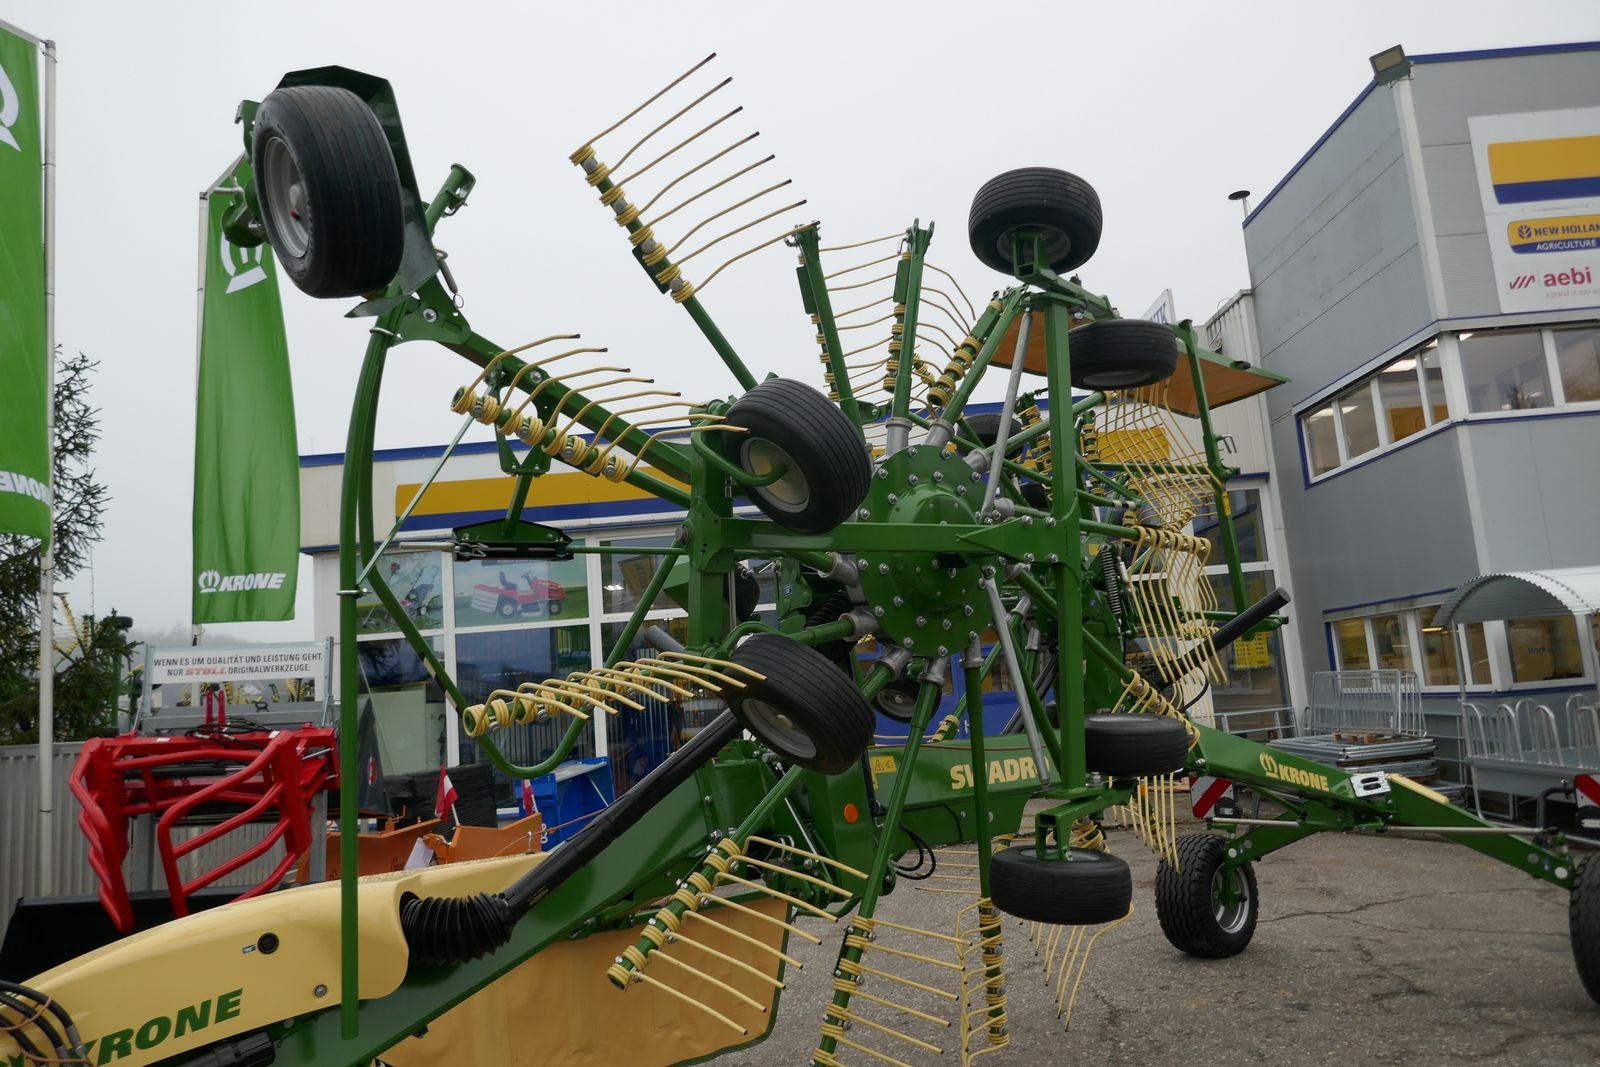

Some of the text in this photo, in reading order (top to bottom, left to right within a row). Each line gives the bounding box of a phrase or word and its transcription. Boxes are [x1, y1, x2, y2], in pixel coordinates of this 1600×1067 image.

[1534, 227, 1559, 236] NEW
[1536, 239, 1597, 251] AGRICULTURE
[1543, 267, 1592, 287] aebi
[219, 573, 287, 592] KRONE
[154, 658, 178, 667] WENN
[180, 657, 190, 665] ES
[191, 657, 205, 665] UM
[206, 654, 243, 665] QUALITÄT
[245, 655, 262, 663] UND
[263, 653, 300, 663] LEISTUNG
[167, 663, 311, 676] NUR STOLL ORIGINALWERKZEUGE.
[1278, 764, 1330, 792] KRONE
